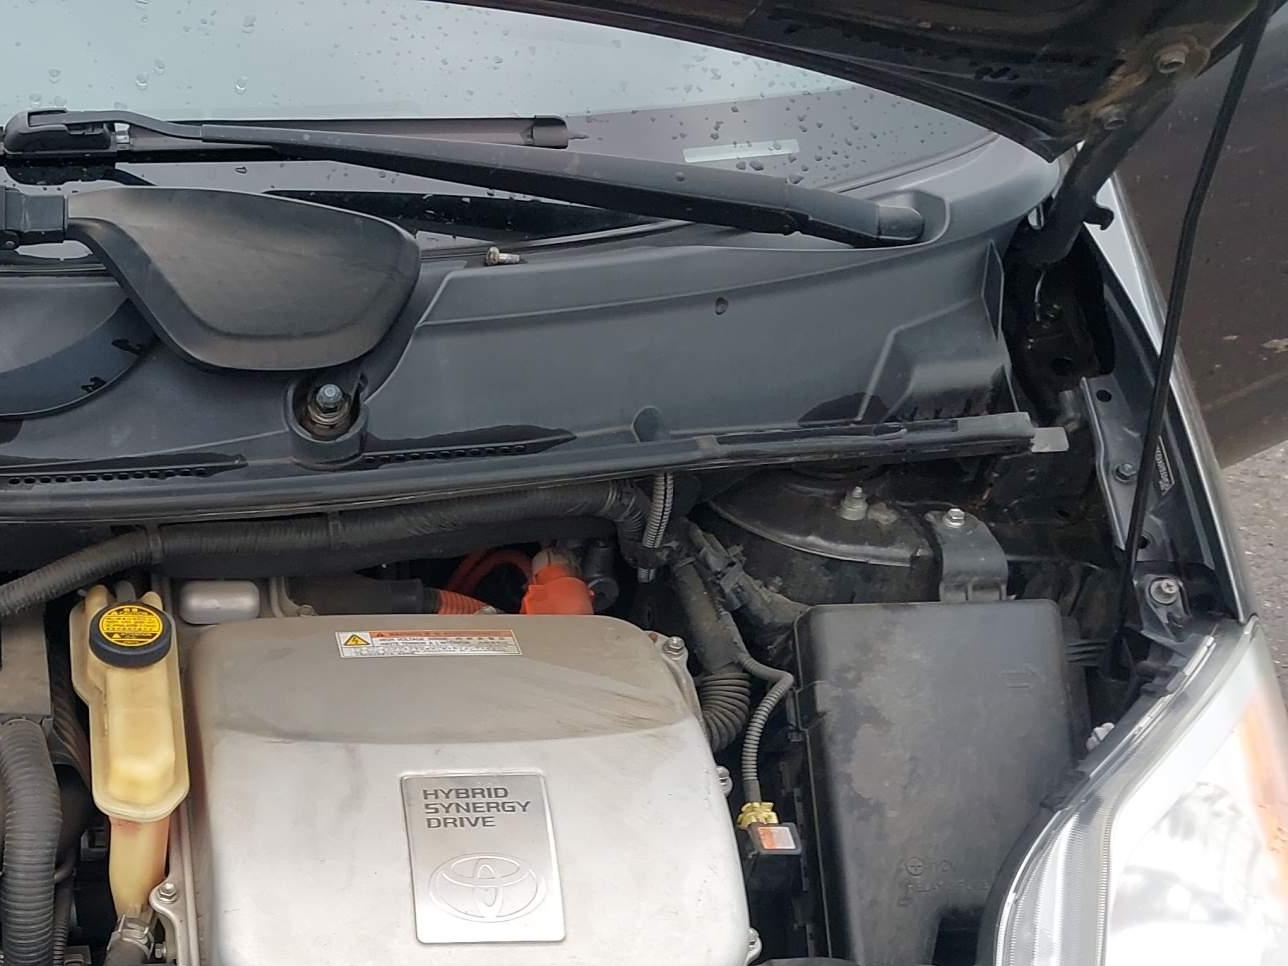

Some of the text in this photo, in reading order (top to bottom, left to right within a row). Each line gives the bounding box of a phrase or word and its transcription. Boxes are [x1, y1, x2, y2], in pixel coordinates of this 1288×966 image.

[423, 787, 509, 799] HYBRID
[425, 801, 531, 814] SYNERGY
[427, 817, 496, 828] DRIVE
